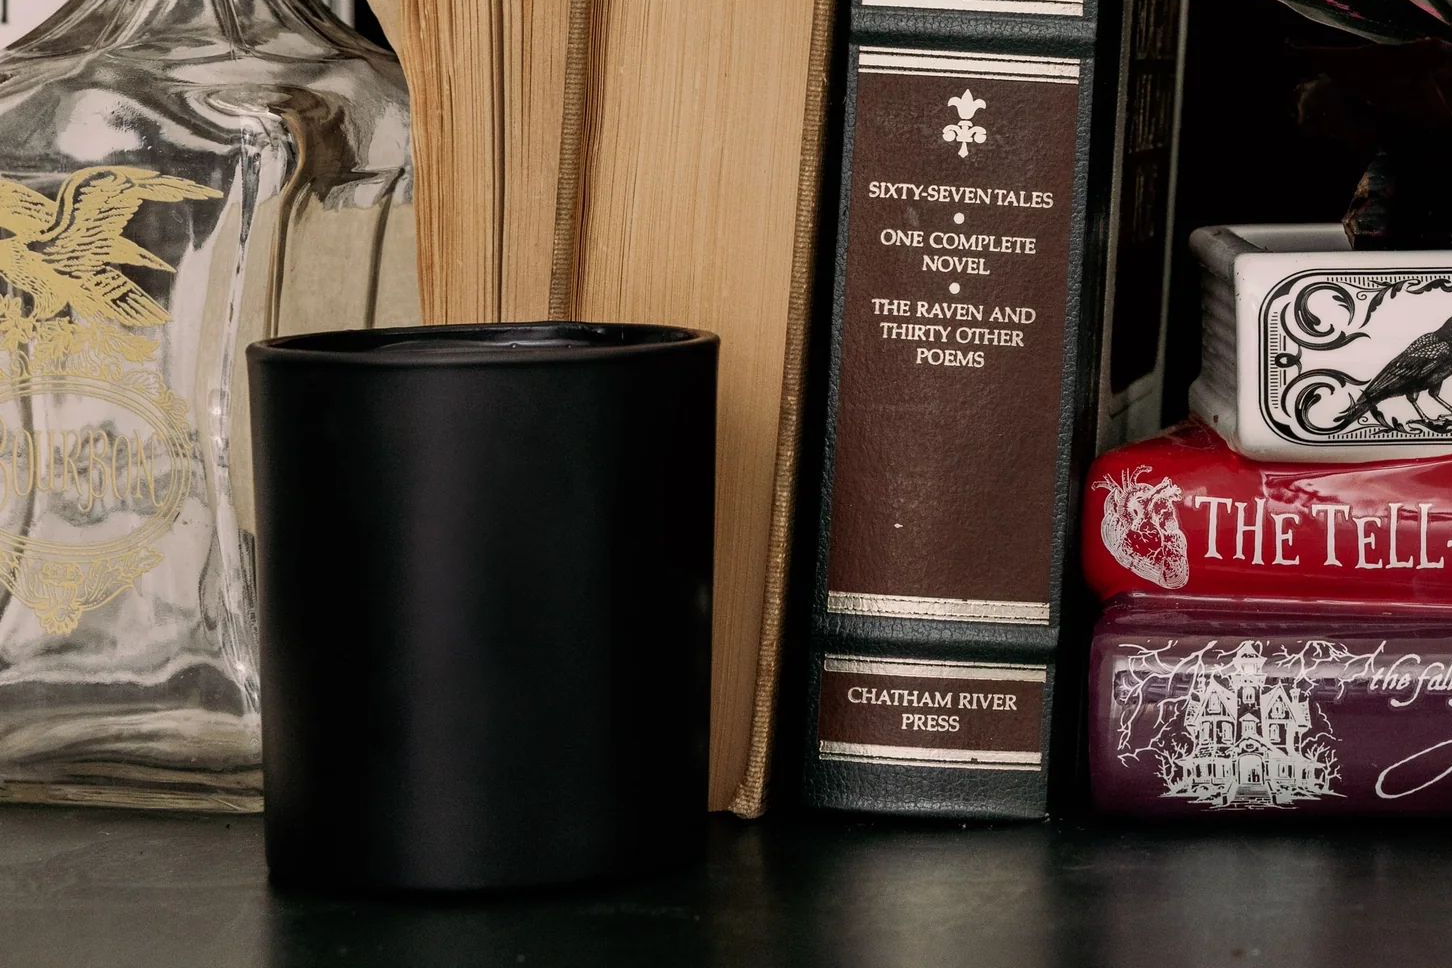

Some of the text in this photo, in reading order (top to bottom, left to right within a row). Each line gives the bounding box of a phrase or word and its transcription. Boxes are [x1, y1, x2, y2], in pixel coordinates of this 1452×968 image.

[868, 181, 1054, 209] SIXTY-SEVEN TALES
[880, 228, 1036, 255] ONE COMPLETE
[922, 255, 990, 275] NOVEL
[871, 298, 1036, 324] THE RAVEN AND
[880, 322, 1024, 348] THIRTY OTHER
[916, 348, 985, 368] POEMS
[1194, 493, 1300, 566] THE
[1370, 654, 1421, 691] the
[847, 686, 1017, 711] CHATHAM RIVER
[901, 713, 960, 732] PRESS
